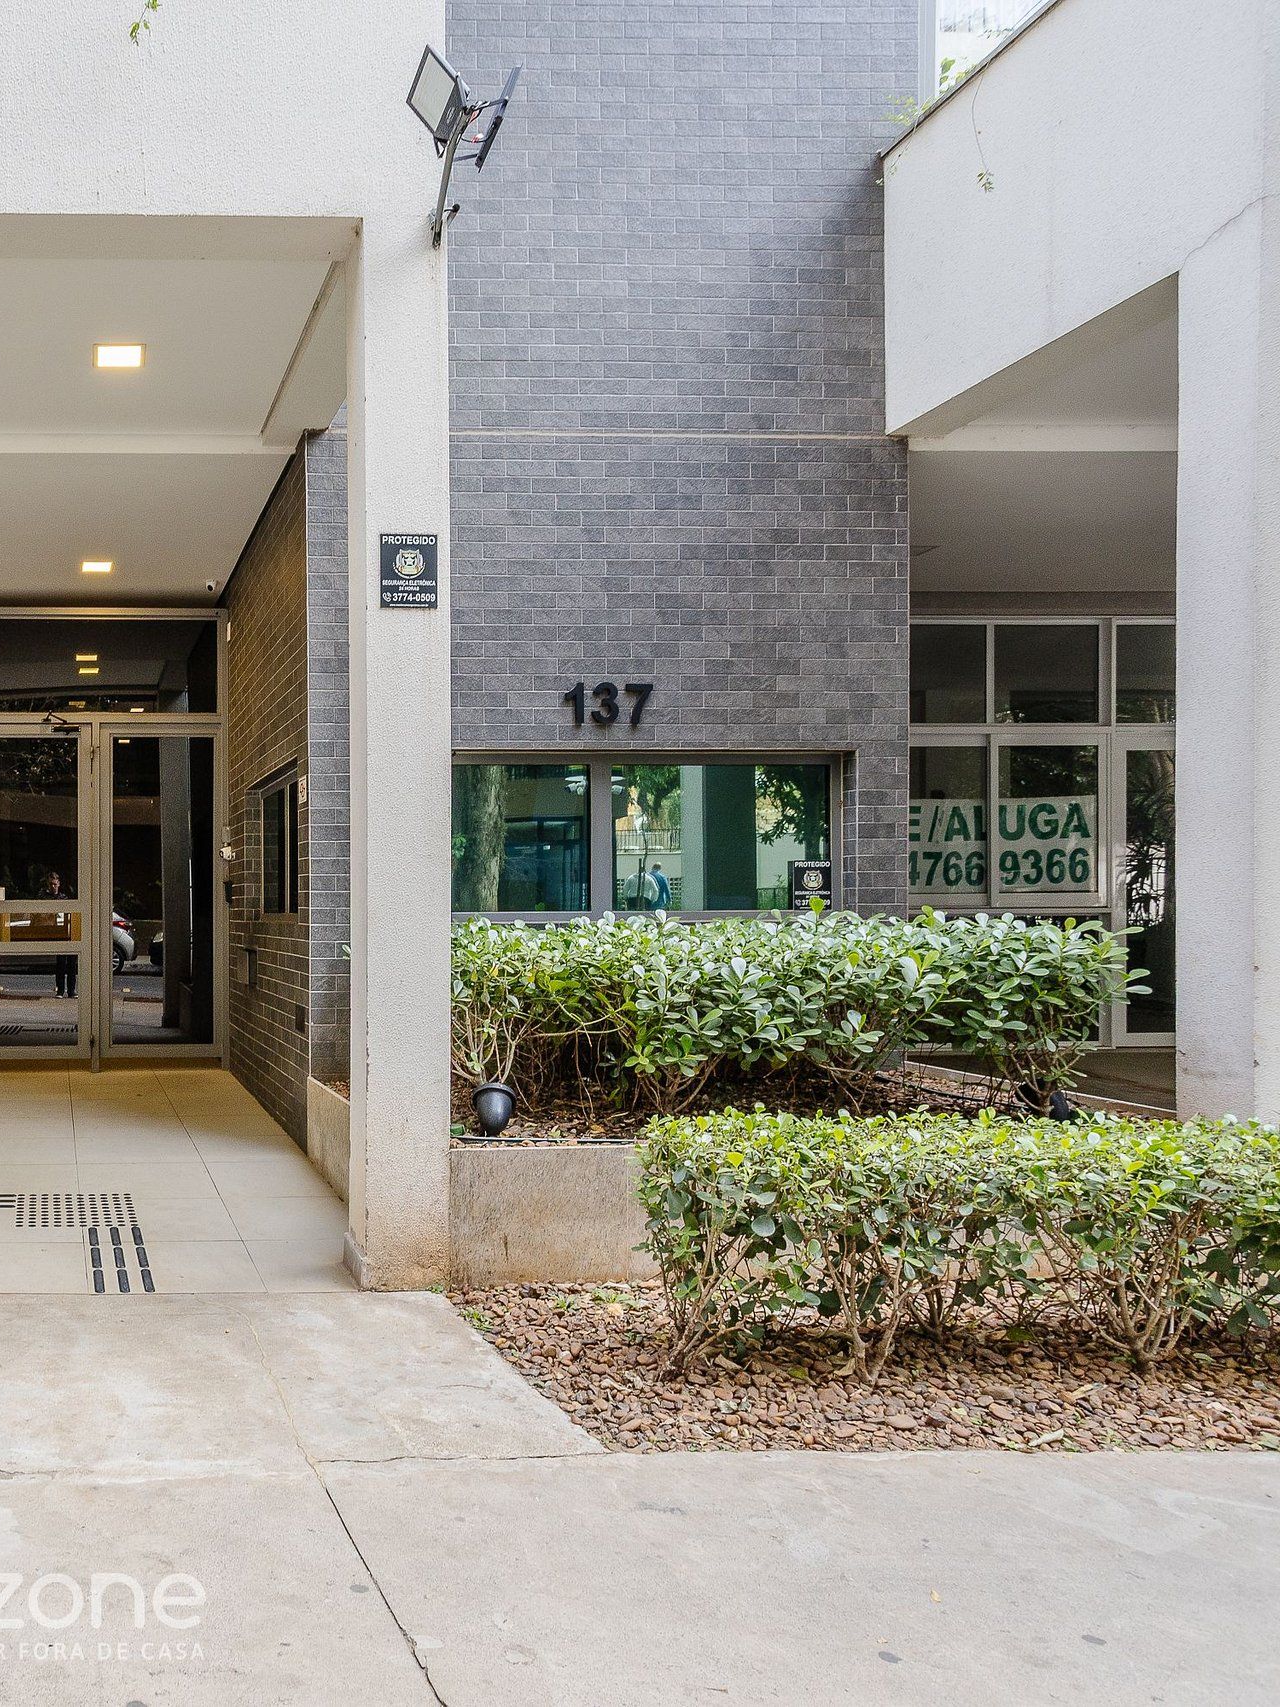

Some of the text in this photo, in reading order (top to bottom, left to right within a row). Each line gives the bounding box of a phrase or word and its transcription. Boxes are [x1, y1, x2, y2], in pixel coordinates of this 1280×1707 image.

[382, 536, 435, 545] PROTEGIDO
[392, 593, 436, 602] 3774-0509
[564, 682, 654, 725] 137
[998, 847, 1090, 886] 9366
